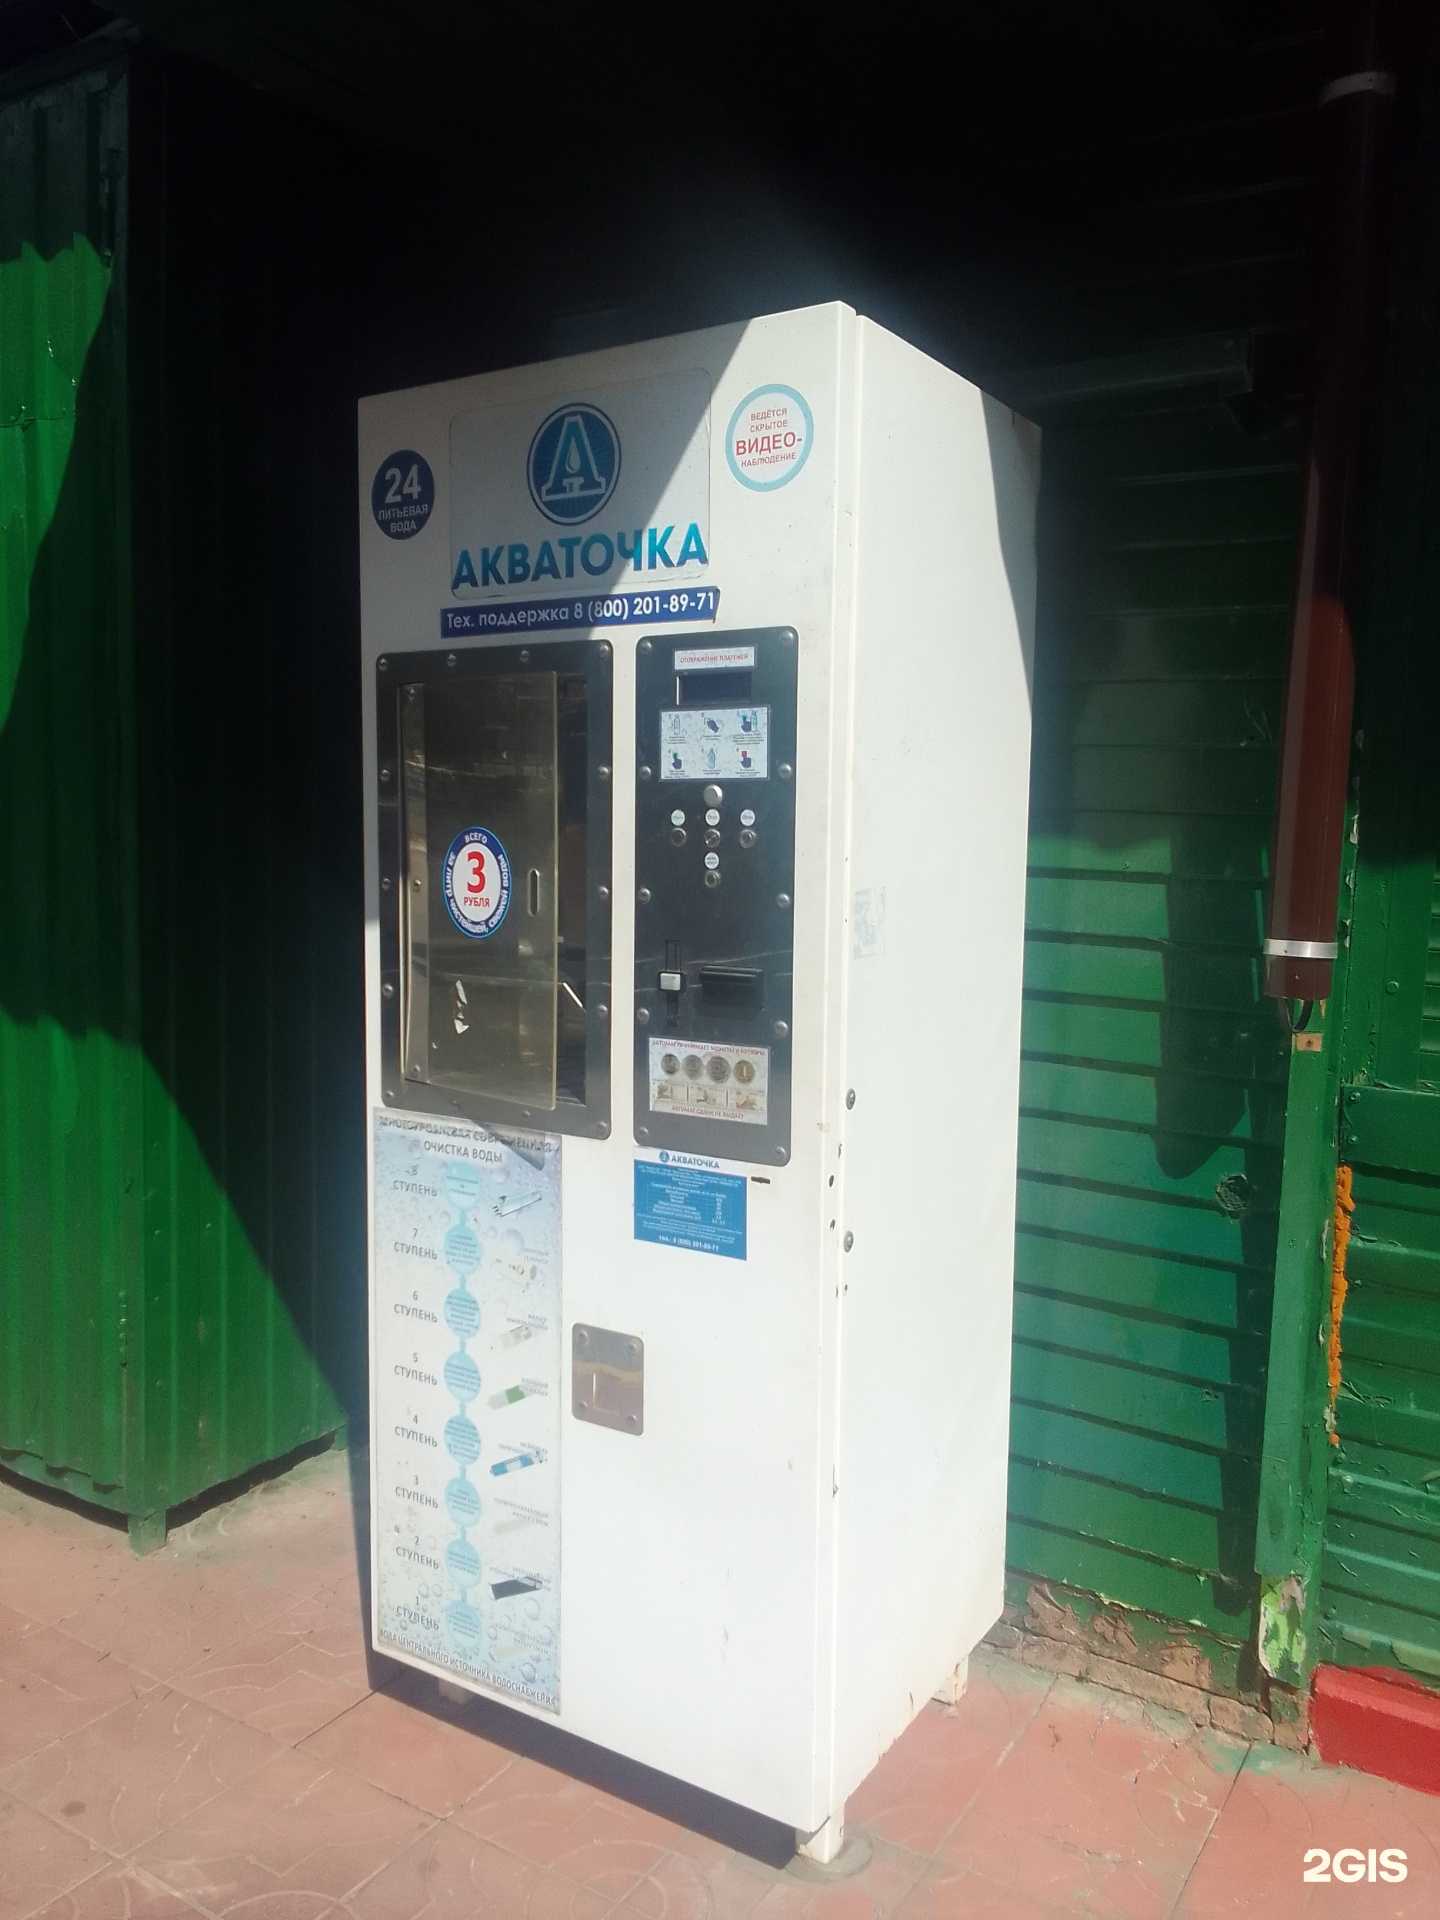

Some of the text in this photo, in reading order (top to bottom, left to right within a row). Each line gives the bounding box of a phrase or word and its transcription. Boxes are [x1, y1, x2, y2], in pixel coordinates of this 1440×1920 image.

[750, 420, 788, 433] СКРЫТОЕ
[736, 431, 803, 456] ВИДЕО-
[741, 453, 797, 469] НАБЛЮДЕНИЕ
[384, 464, 422, 504] 24
[378, 503, 429, 521] ПИТЬЕВАЯ
[390, 520, 417, 534] ВОДА
[452, 522, 710, 591] АКВАТОЧКА
[447, 591, 715, 629] Тех. поддержка 8 (800) 201-89-71
[467, 850, 486, 894] 3
[463, 896, 490, 908] РУБЛЯ
[423, 1140, 503, 1163] ОЧИСТКА ВОДЫ
[671, 1155, 720, 1169] АКВАТОЧКА
[393, 1179, 438, 1197] СТУПЕНЬ
[393, 1241, 438, 1260] СТУПЕНЬ
[412, 1290, 418, 1300] 6
[393, 1303, 438, 1323] СТУПЕНЬ
[413, 1352, 418, 1363] 5
[394, 1365, 438, 1386] СТУПЕНЬ
[413, 1415, 418, 1424] 4
[394, 1426, 438, 1448] СТУПЕНЬ
[395, 1486, 439, 1509] СТУПЕНЬ
[395, 1546, 439, 1570] СТУПЕНЬ
[396, 1606, 440, 1631] СТУПЕНЬ
[450, 1656, 490, 1680] ИСТОЧНИКА
